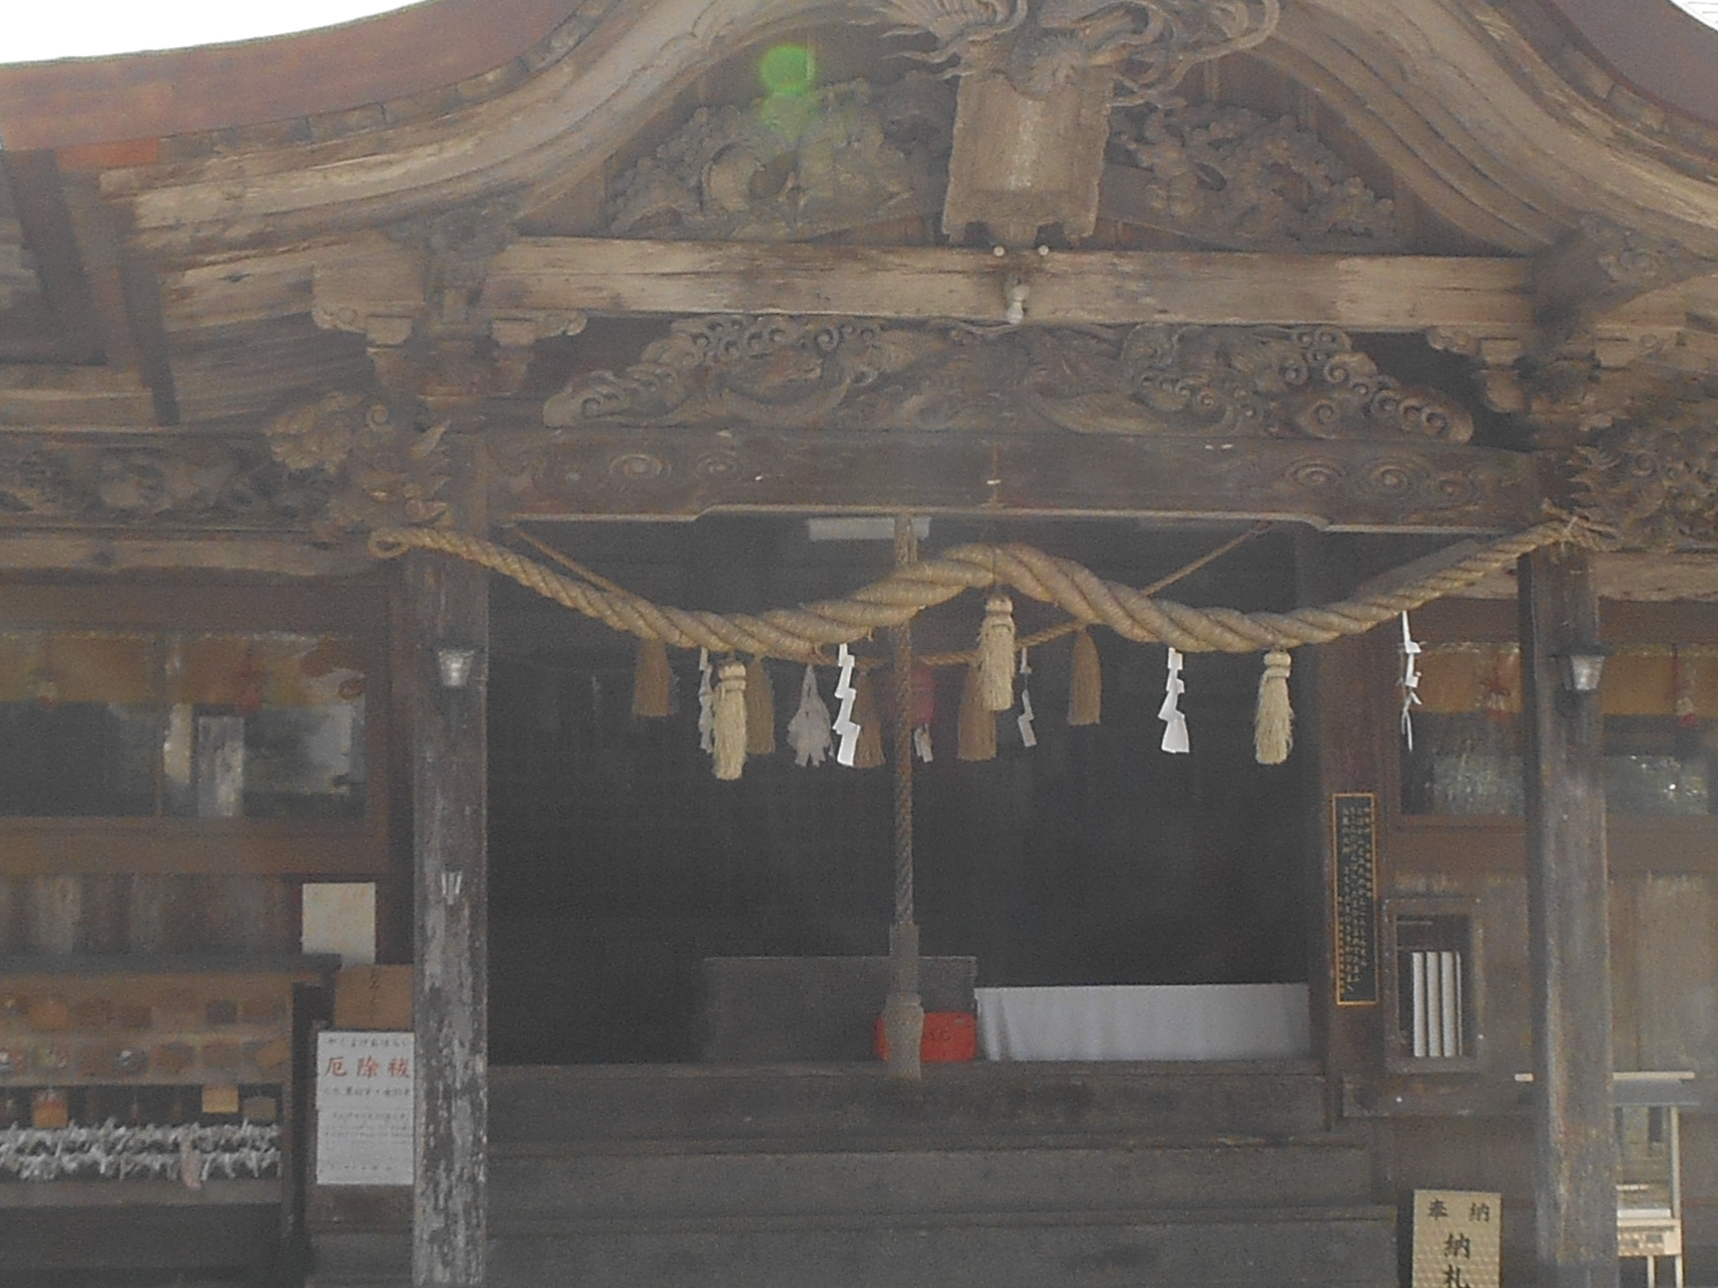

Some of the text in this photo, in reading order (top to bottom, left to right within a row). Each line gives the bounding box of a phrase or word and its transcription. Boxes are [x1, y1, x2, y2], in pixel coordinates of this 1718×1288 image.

[325, 1055, 411, 1079] 厄除祓
[1427, 1198, 1490, 1223] 奉納
